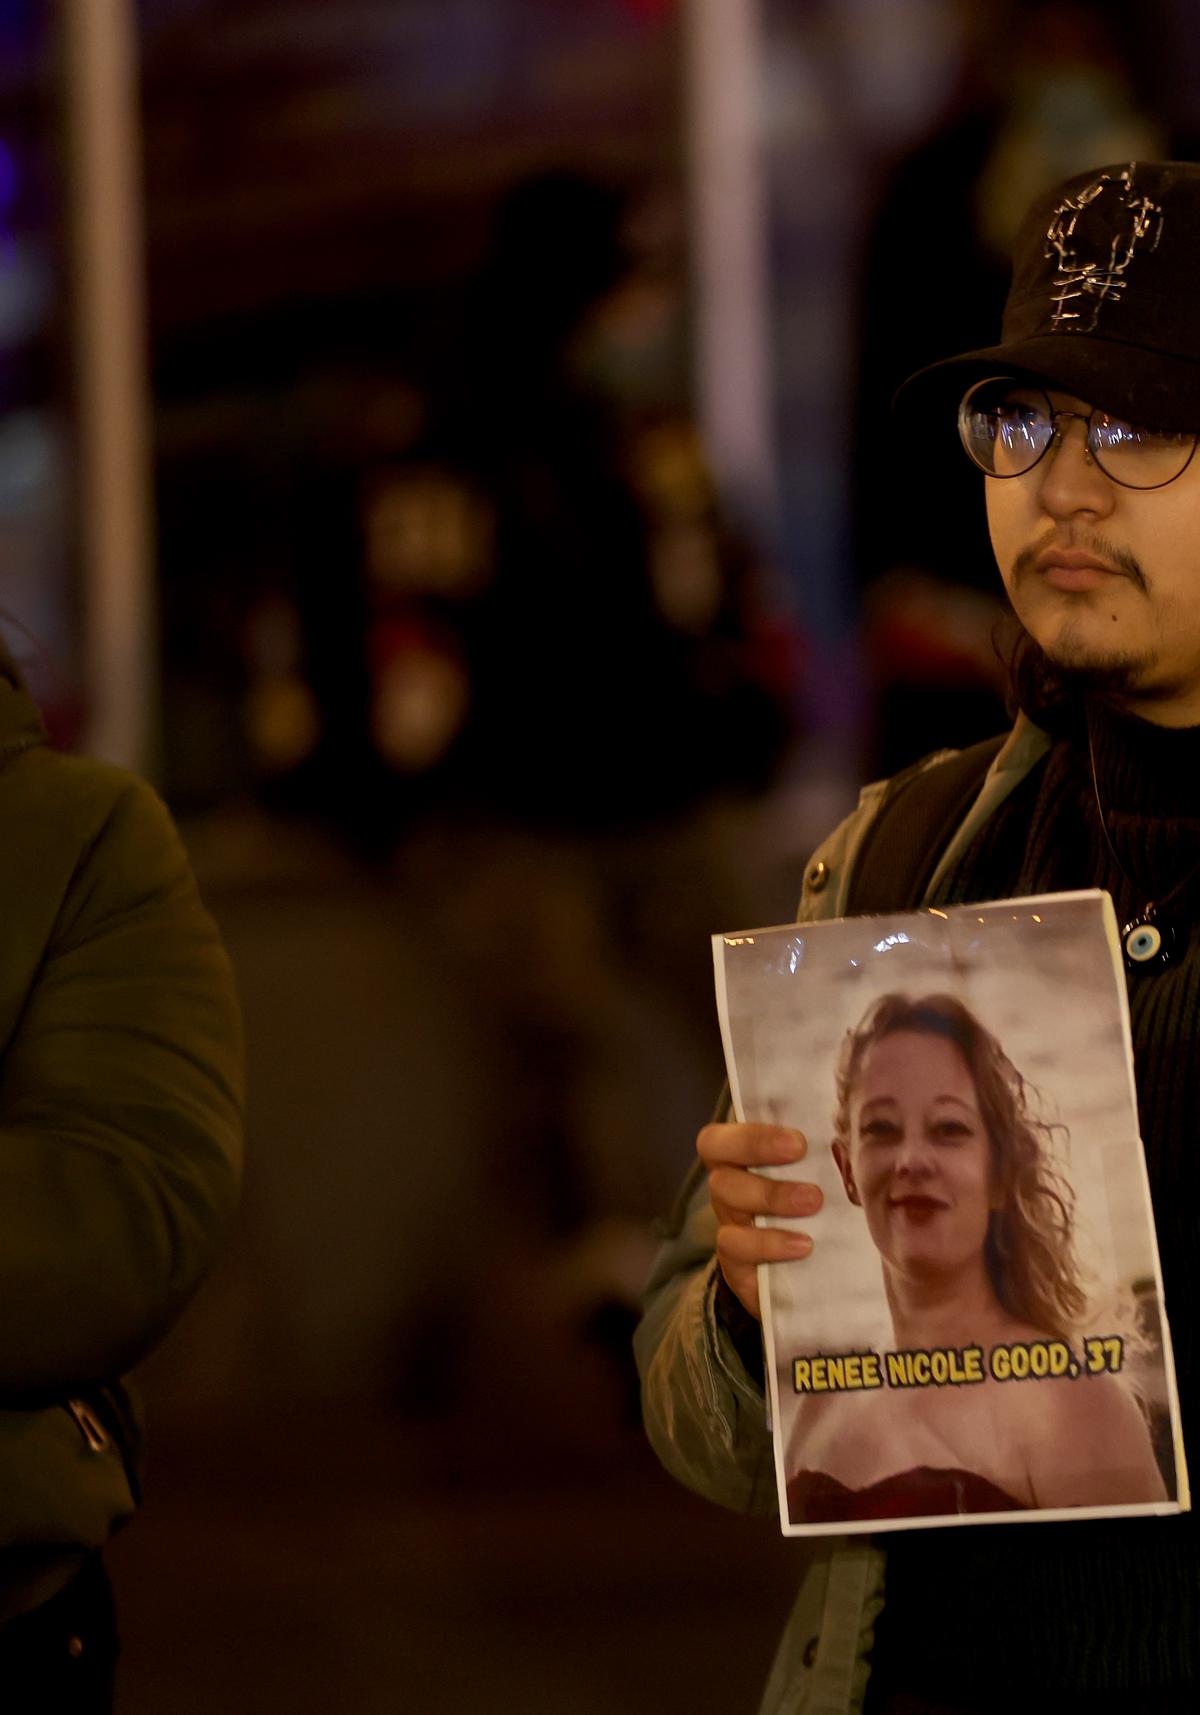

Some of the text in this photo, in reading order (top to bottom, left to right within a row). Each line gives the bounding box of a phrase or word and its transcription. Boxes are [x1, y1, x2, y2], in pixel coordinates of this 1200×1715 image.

[793, 1337, 1124, 1392] RENEE NICOLE GOOD, 37
